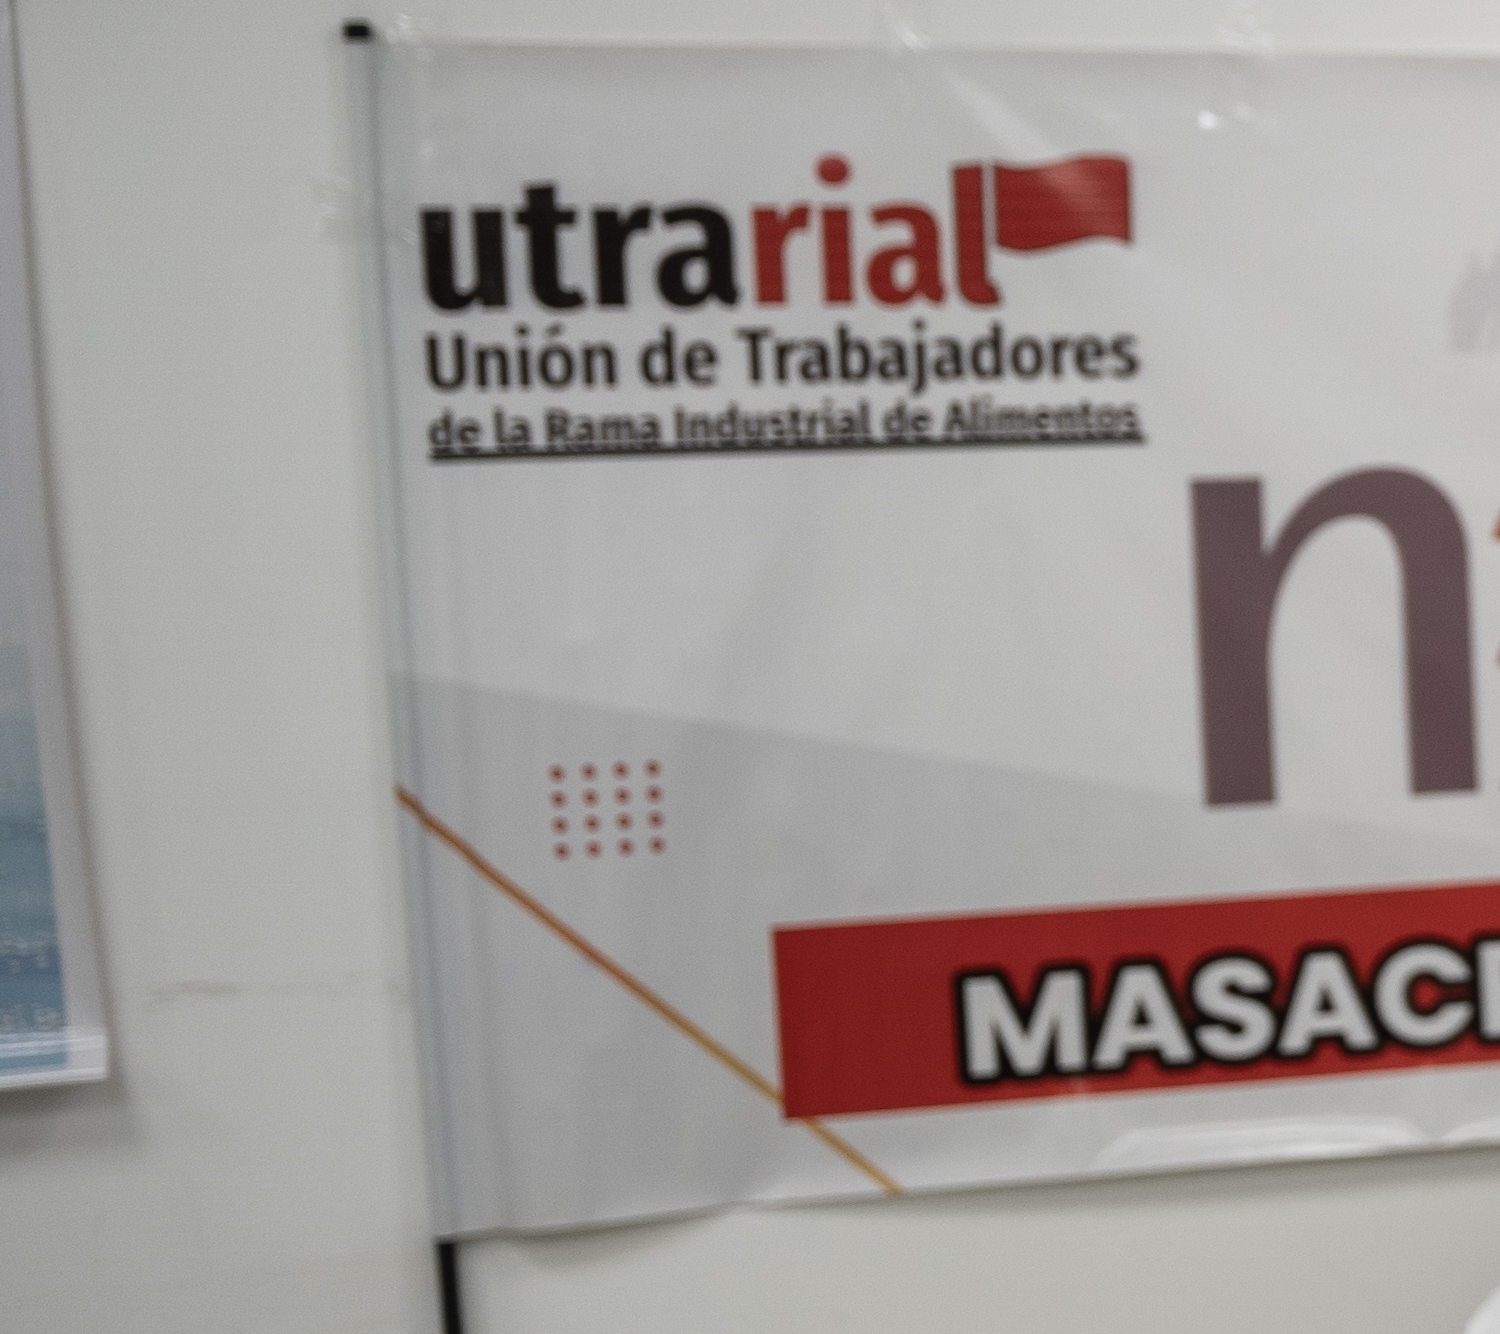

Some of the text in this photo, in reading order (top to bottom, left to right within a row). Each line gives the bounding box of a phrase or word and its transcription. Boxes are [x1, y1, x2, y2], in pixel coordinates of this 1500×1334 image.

[420, 153, 1004, 312] utrarial
[425, 317, 1140, 395] Unión de Trabajadores
[428, 395, 1143, 449] de la Rama Industrial de Alimentos
